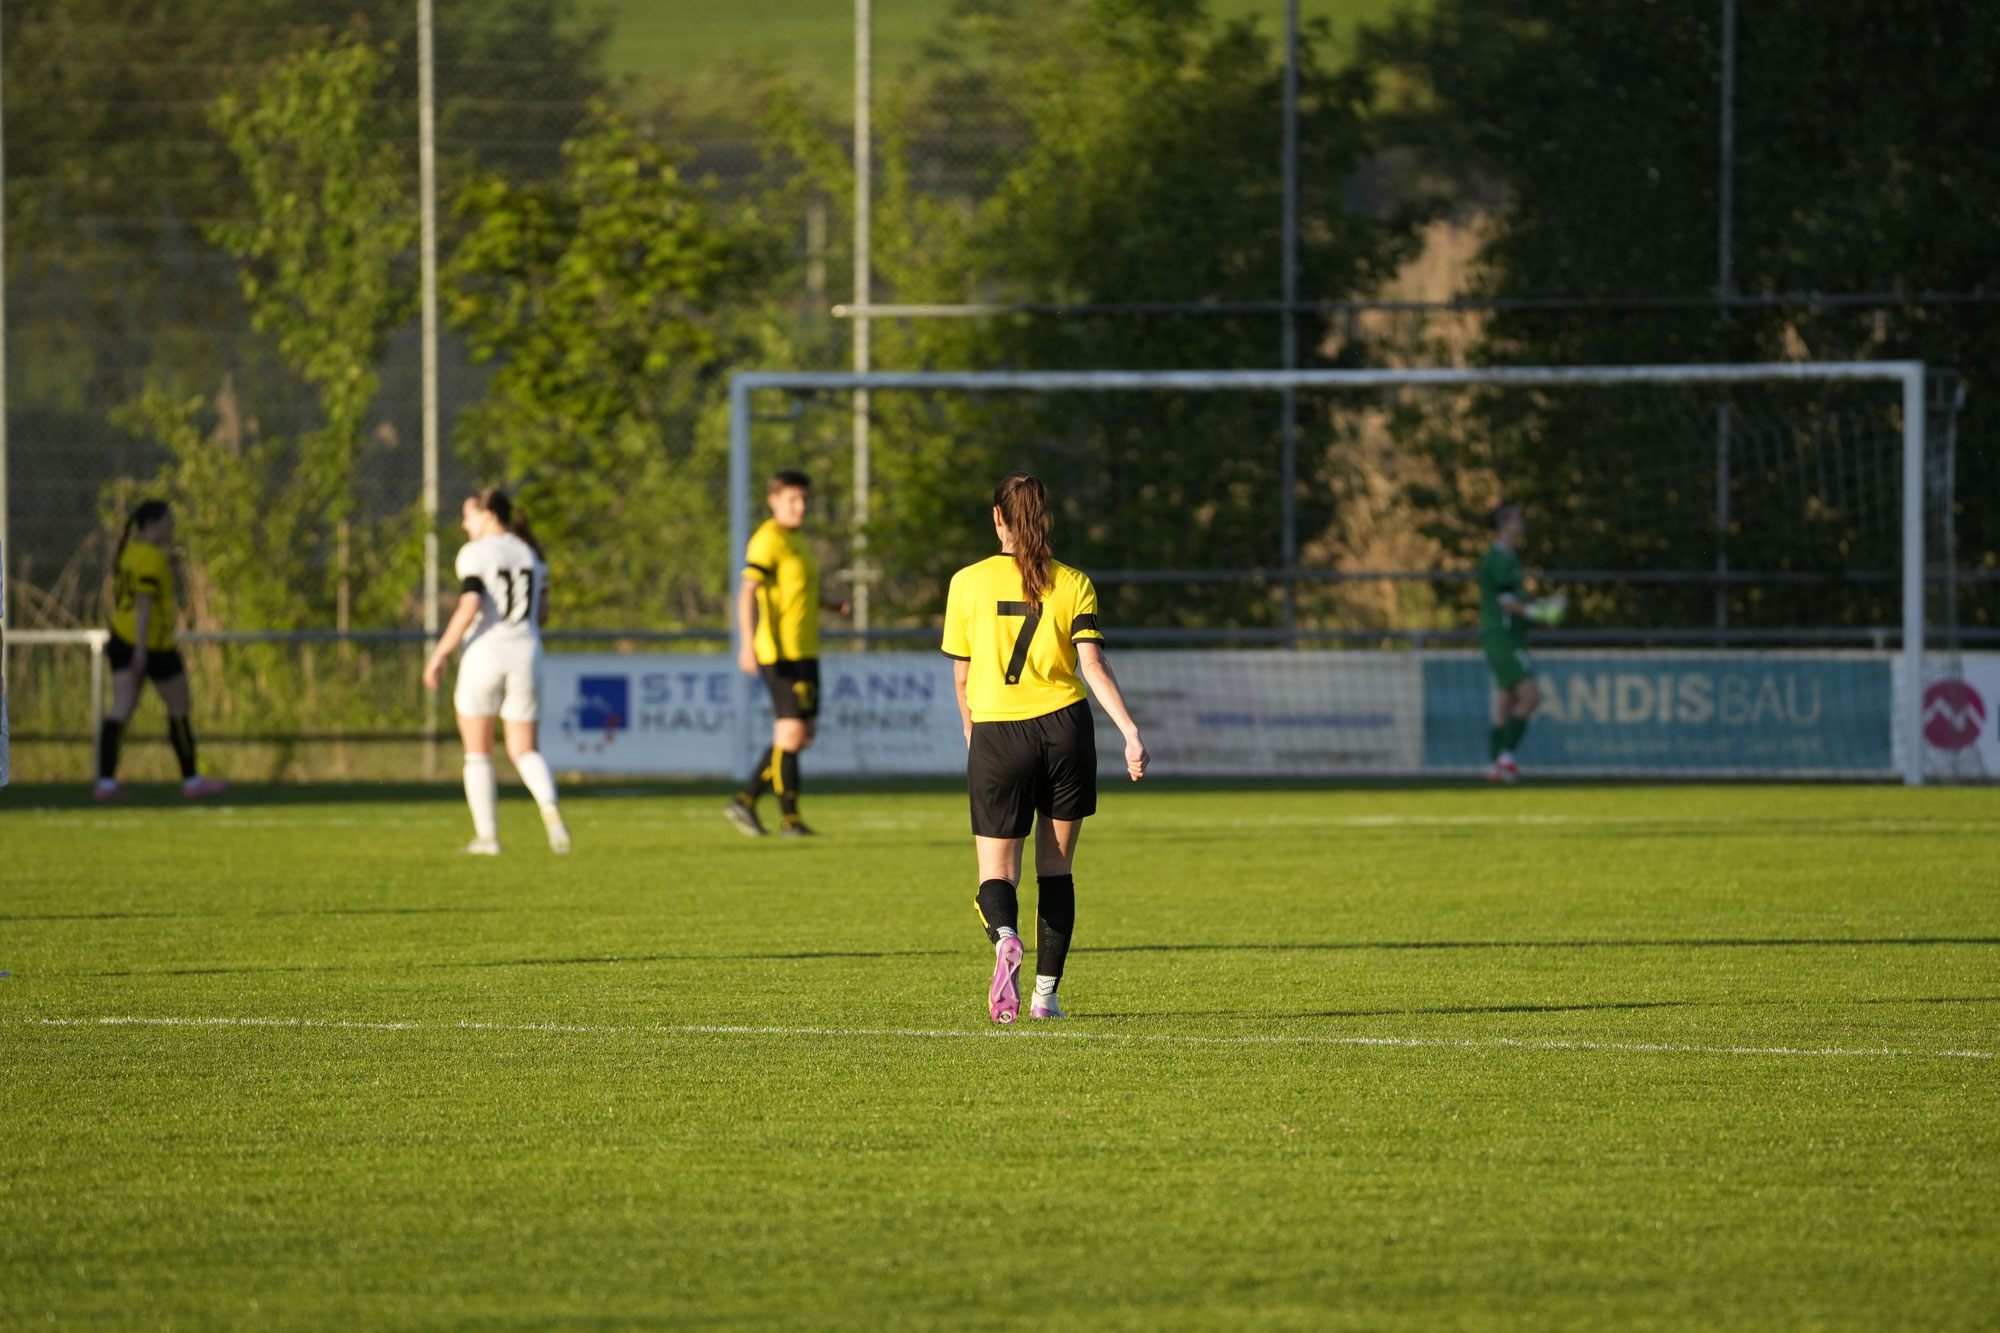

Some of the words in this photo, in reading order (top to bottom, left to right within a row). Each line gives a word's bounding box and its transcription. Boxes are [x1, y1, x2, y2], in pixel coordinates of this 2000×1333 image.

[997, 601, 1043, 684] 7
[641, 671, 936, 704] STEANN
[1490, 672, 1823, 726] ANDISBAU
